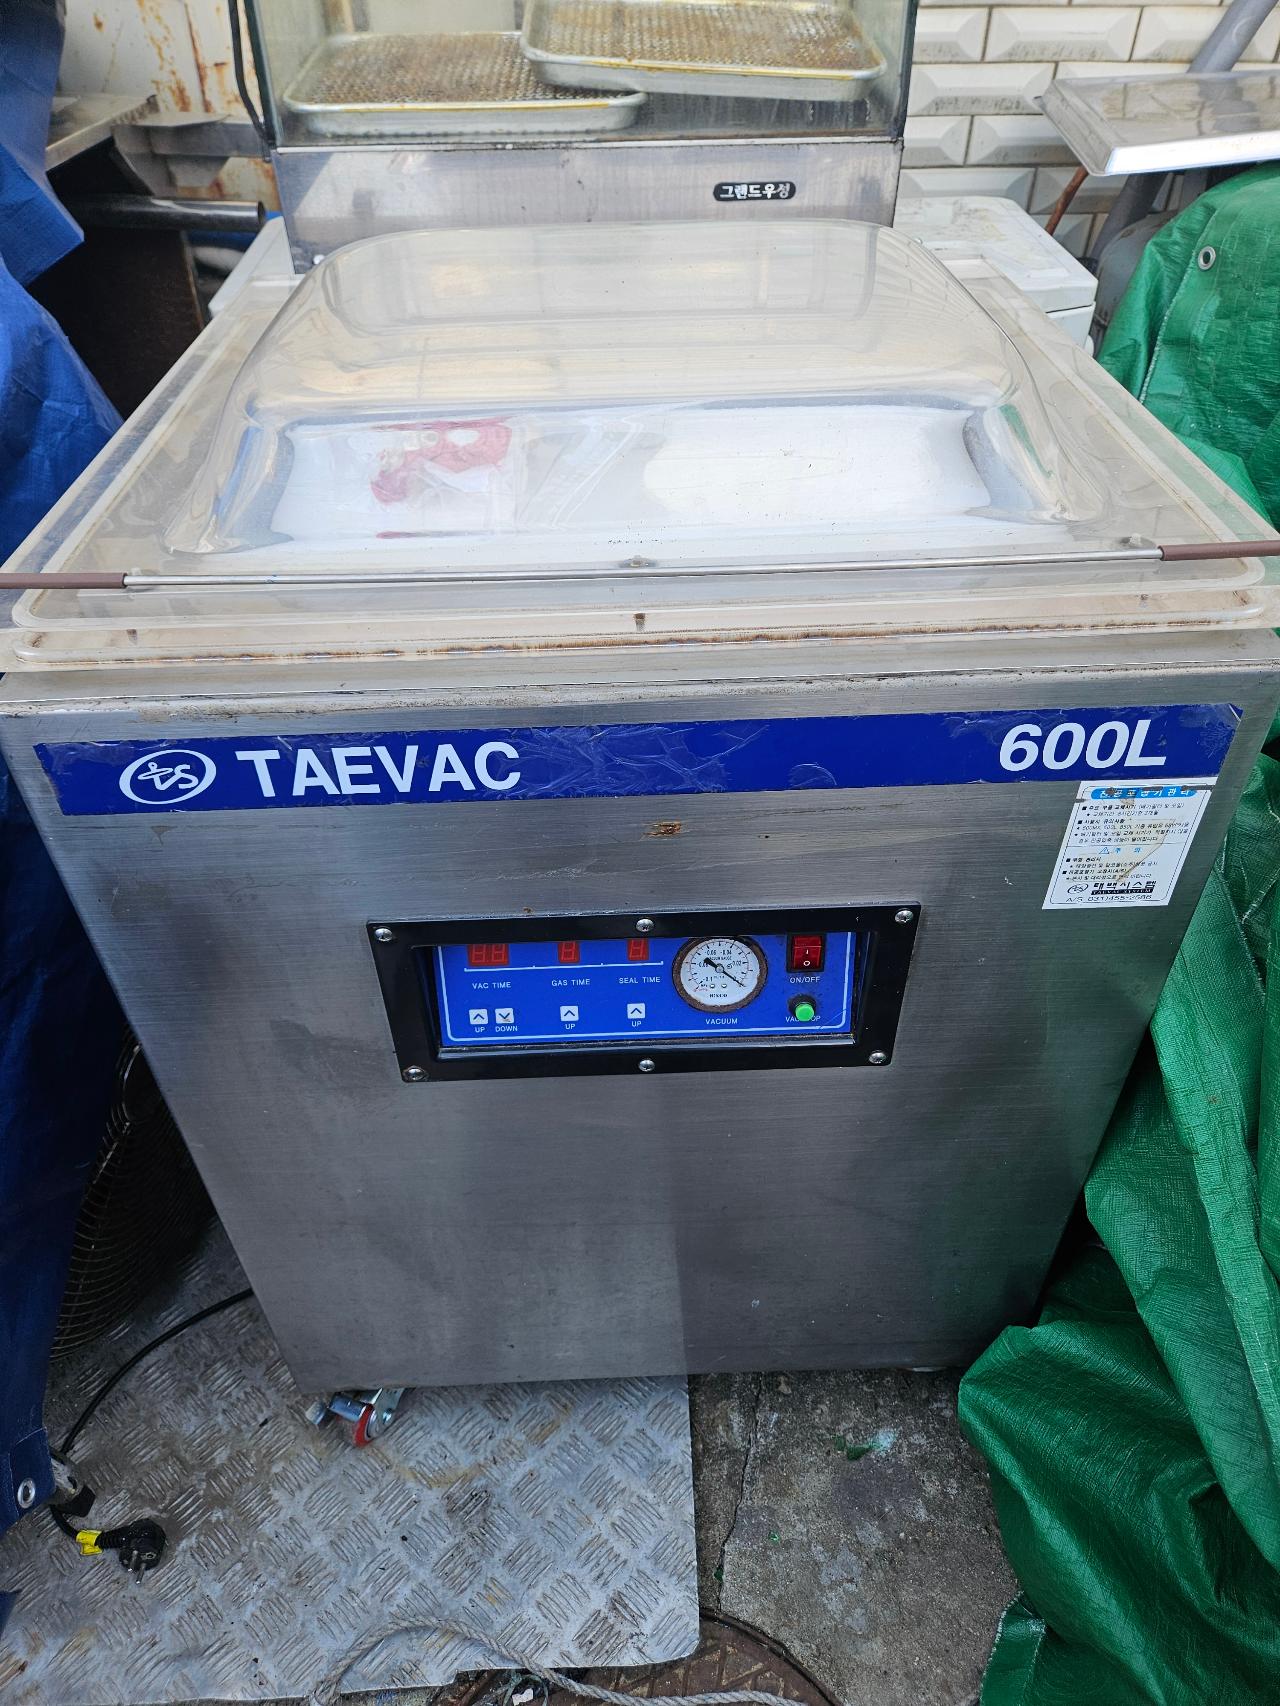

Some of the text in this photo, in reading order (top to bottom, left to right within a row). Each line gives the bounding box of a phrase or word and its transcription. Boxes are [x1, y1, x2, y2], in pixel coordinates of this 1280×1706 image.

[999, 719, 1167, 772] 600L
[235, 741, 521, 798] TAEVAC
[1093, 880, 1157, 890] 태백시스템
[551, 978, 590, 987] GAS TIME
[619, 976, 661, 985] SEAL TIME
[789, 976, 821, 984] ON/OFF
[472, 981, 511, 990] VAC TIME
[705, 1017, 738, 1025] VACUUM
[495, 1025, 518, 1033] DOWN
